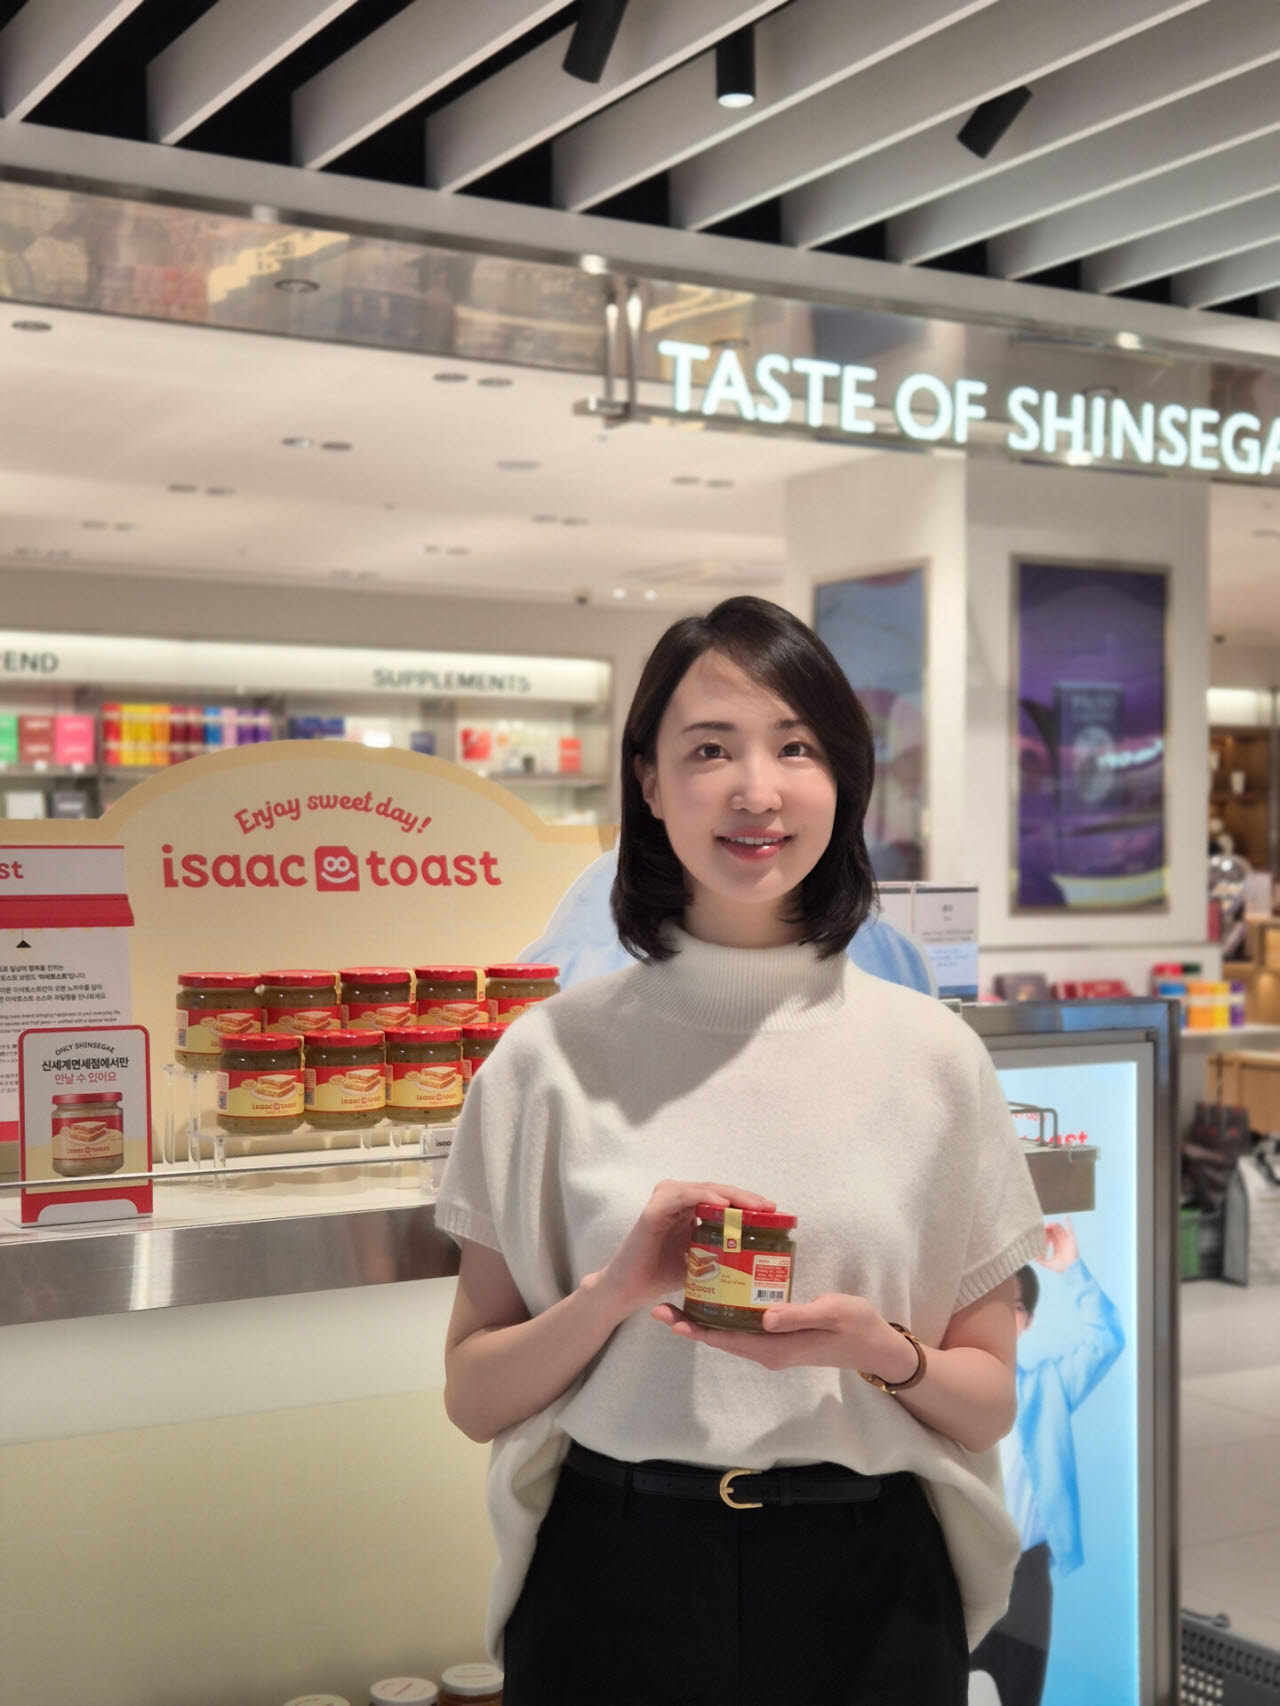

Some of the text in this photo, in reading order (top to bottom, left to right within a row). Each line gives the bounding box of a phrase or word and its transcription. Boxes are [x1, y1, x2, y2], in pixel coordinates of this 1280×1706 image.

[658, 340, 877, 433] TASTE
[895, 373, 987, 443] OF
[372, 668, 531, 693] SUPPLEMENTS
[233, 791, 432, 835] Enjoy sweet day!
[161, 844, 503, 888] isaac toast
[55, 1041, 116, 1056] ONLY SHINSEGAE
[42, 1057, 129, 1071] 신세계면세점에서만
[55, 1071, 117, 1085] 만날 수 있어요
